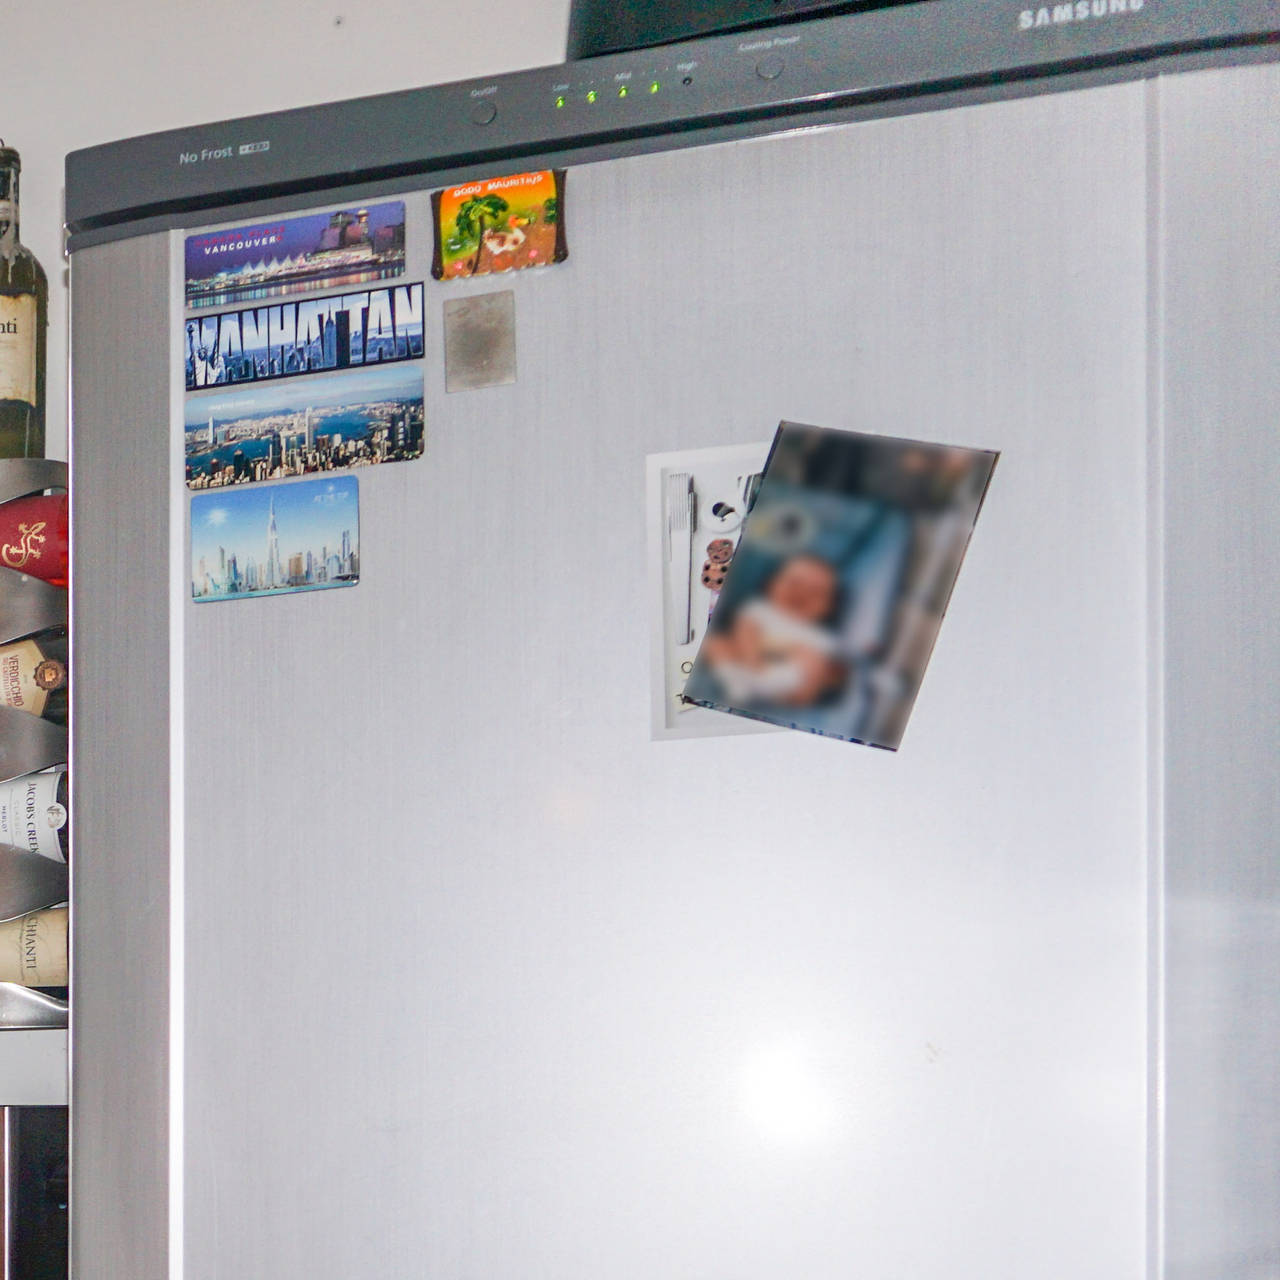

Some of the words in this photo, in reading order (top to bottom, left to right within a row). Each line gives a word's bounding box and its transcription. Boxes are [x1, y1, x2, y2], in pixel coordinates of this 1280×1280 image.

[180, 153, 198, 164] No
[201, 146, 233, 160] Frost
[204, 235, 277, 255] VANCOUVER
[9, 655, 24, 707] VERDICCHIO
[25, 917, 38, 969] CHIANTI
